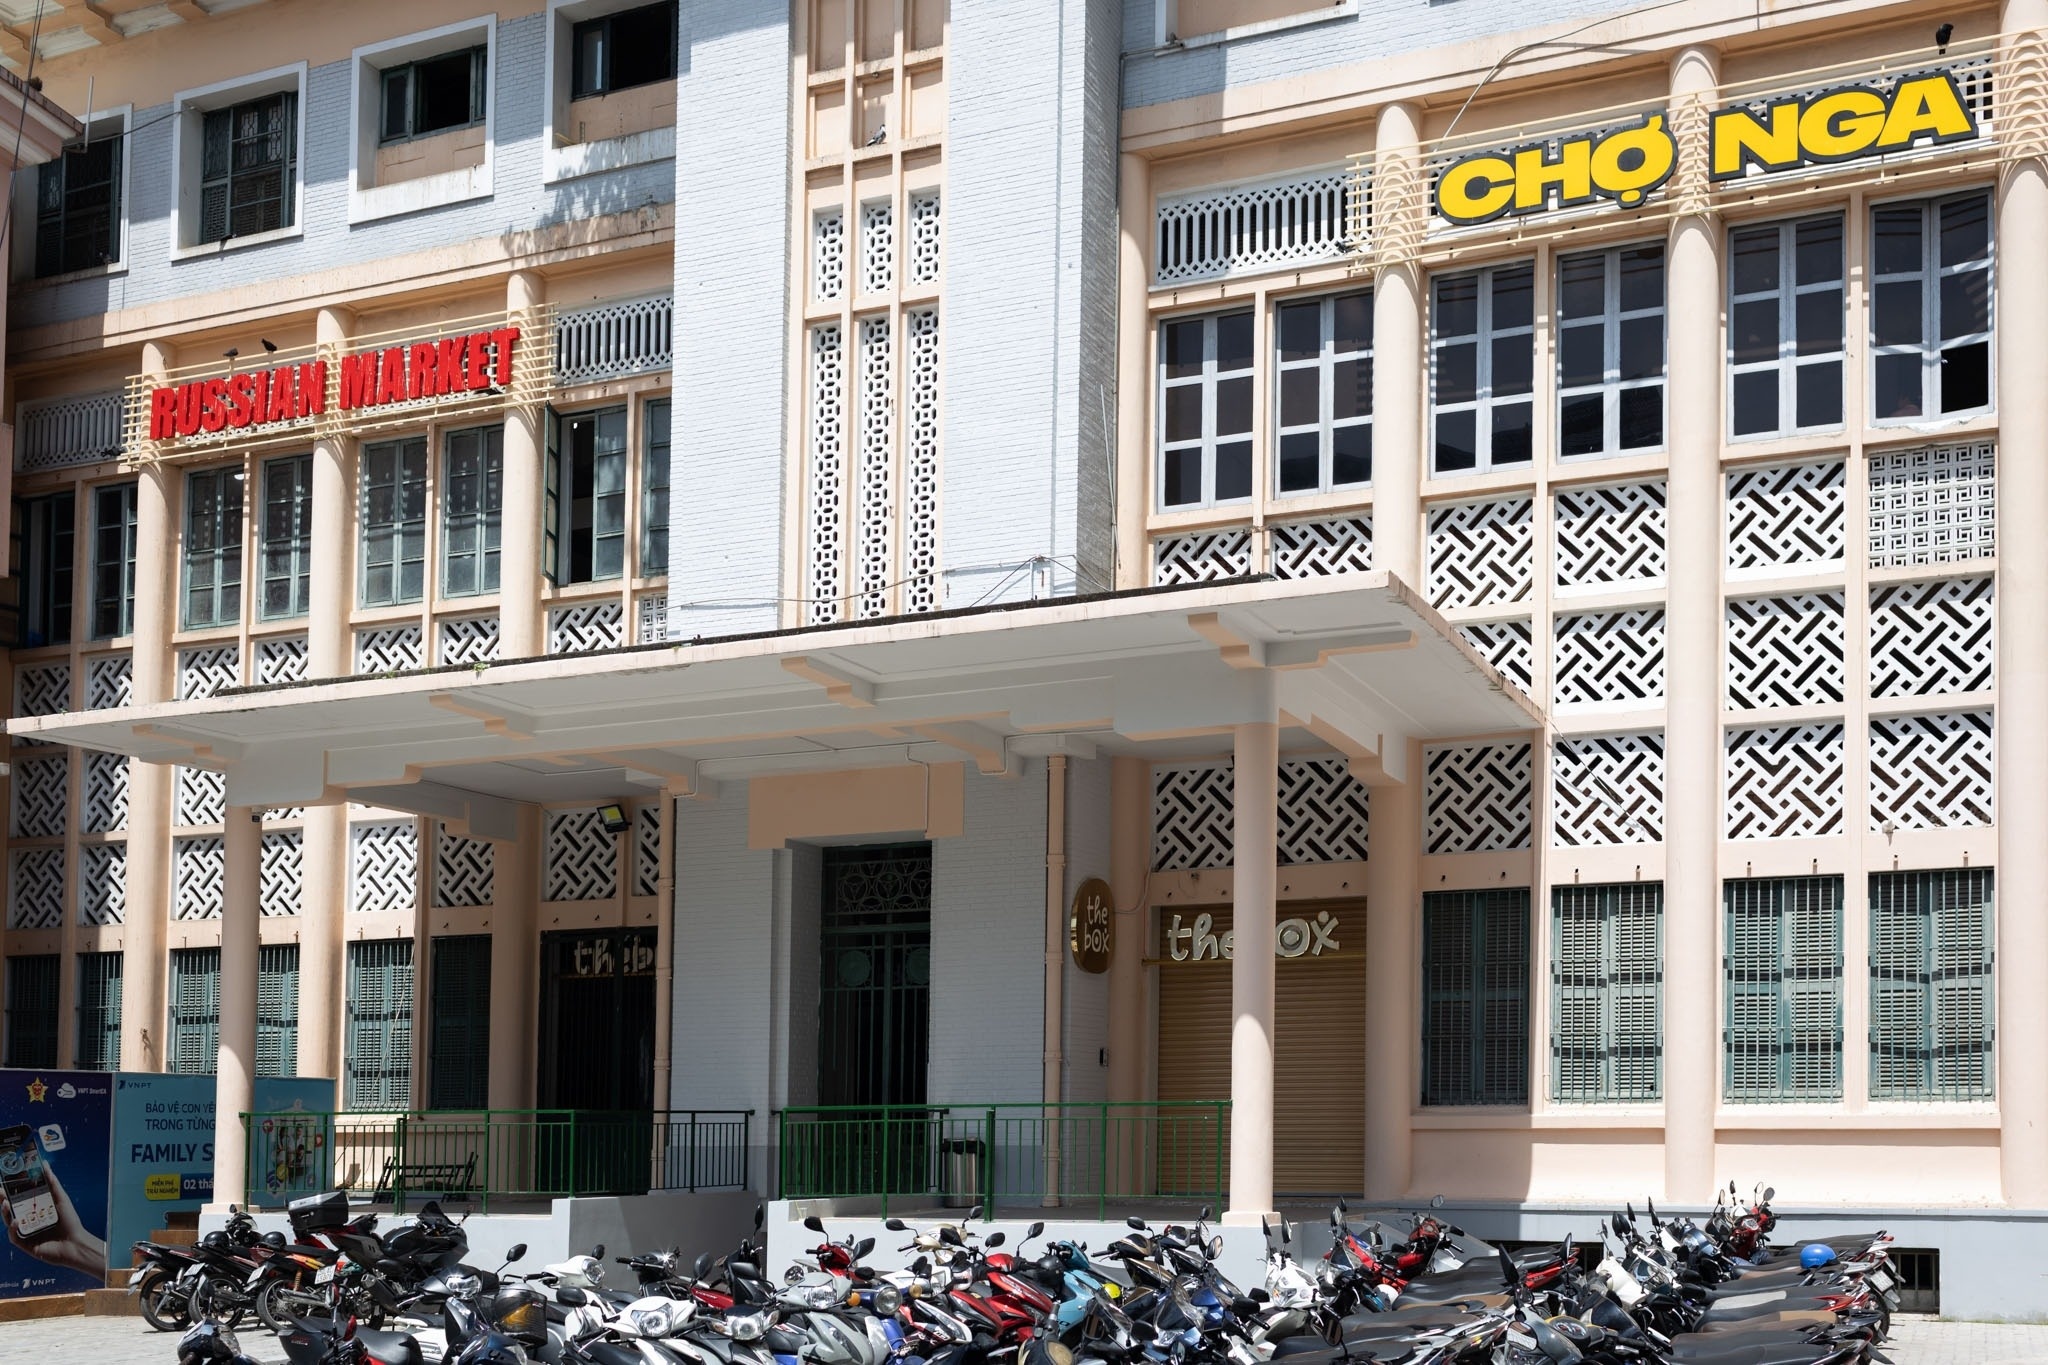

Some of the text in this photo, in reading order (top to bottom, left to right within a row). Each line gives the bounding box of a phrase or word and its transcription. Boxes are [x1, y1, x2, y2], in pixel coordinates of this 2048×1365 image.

[1437, 75, 1973, 221] CHỢ NGA
[149, 327, 521, 441] RUSSIAN MARKET
[1086, 895, 1108, 925] the
[1084, 922, 1110, 953] box
[1167, 910, 1341, 961] the ox
[182, 1103, 201, 1113] CON
[145, 1119, 184, 1131] TRONG
[131, 1142, 214, 1163] FAMILY S
[183, 1177, 215, 1190] 02 thá
[32, 1278, 56, 1287] VNPT
